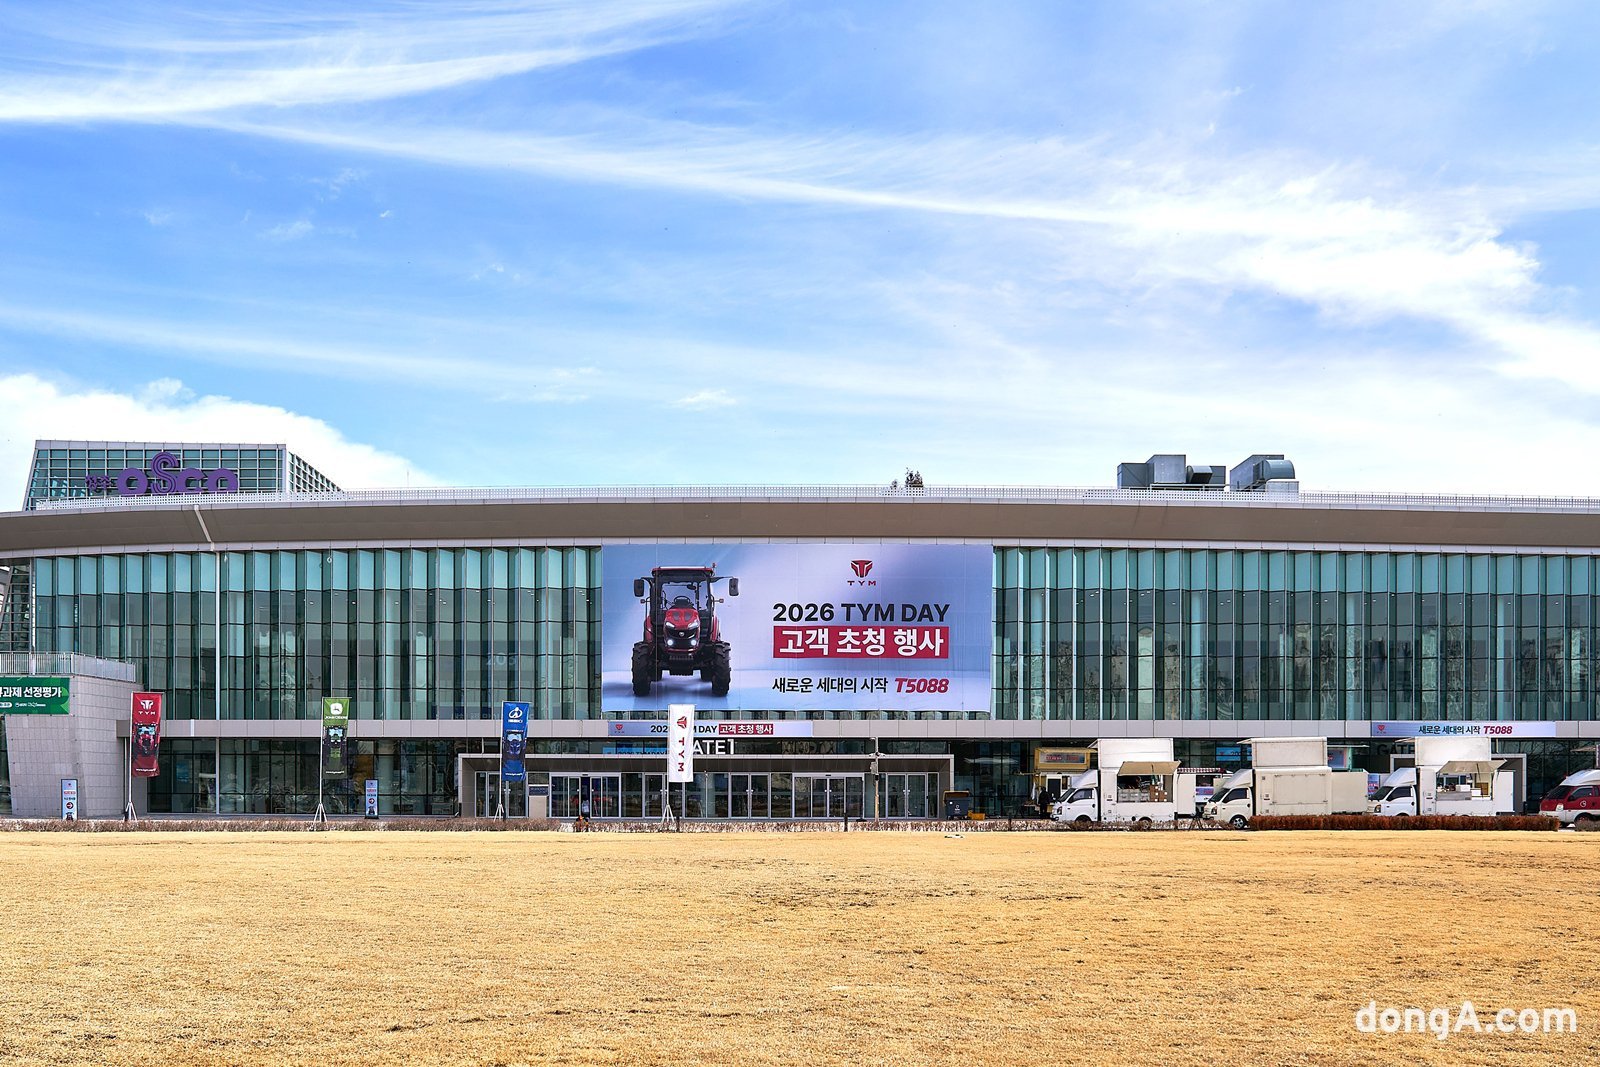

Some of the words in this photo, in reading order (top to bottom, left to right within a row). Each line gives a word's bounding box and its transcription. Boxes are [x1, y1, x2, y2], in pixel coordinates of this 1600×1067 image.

[773, 603, 834, 622] 2026
[841, 603, 895, 622] TYM
[901, 603, 950, 622] DAY
[779, 628, 829, 656] 고객
[836, 628, 885, 656] 초청
[893, 628, 944, 656] 행사
[23, 686, 62, 698] 선정평가
[772, 677, 813, 693] 새로운
[816, 677, 857, 693] 세대의
[860, 677, 888, 693] 시작
[895, 678, 949, 694] T5088
[650, 725, 668, 733] 202
[698, 725, 717, 733] DAY
[719, 725, 736, 734] 고객
[738, 725, 754, 734] 초청
[755, 725, 772, 734] 행사
[1418, 725, 1441, 734] 새로운
[1442, 725, 1465, 734] 세대의
[1466, 725, 1480, 734] 시작
[1484, 726, 1513, 734] T5088
[677, 737, 685, 772] TYM
[693, 739, 735, 755] ATE1
